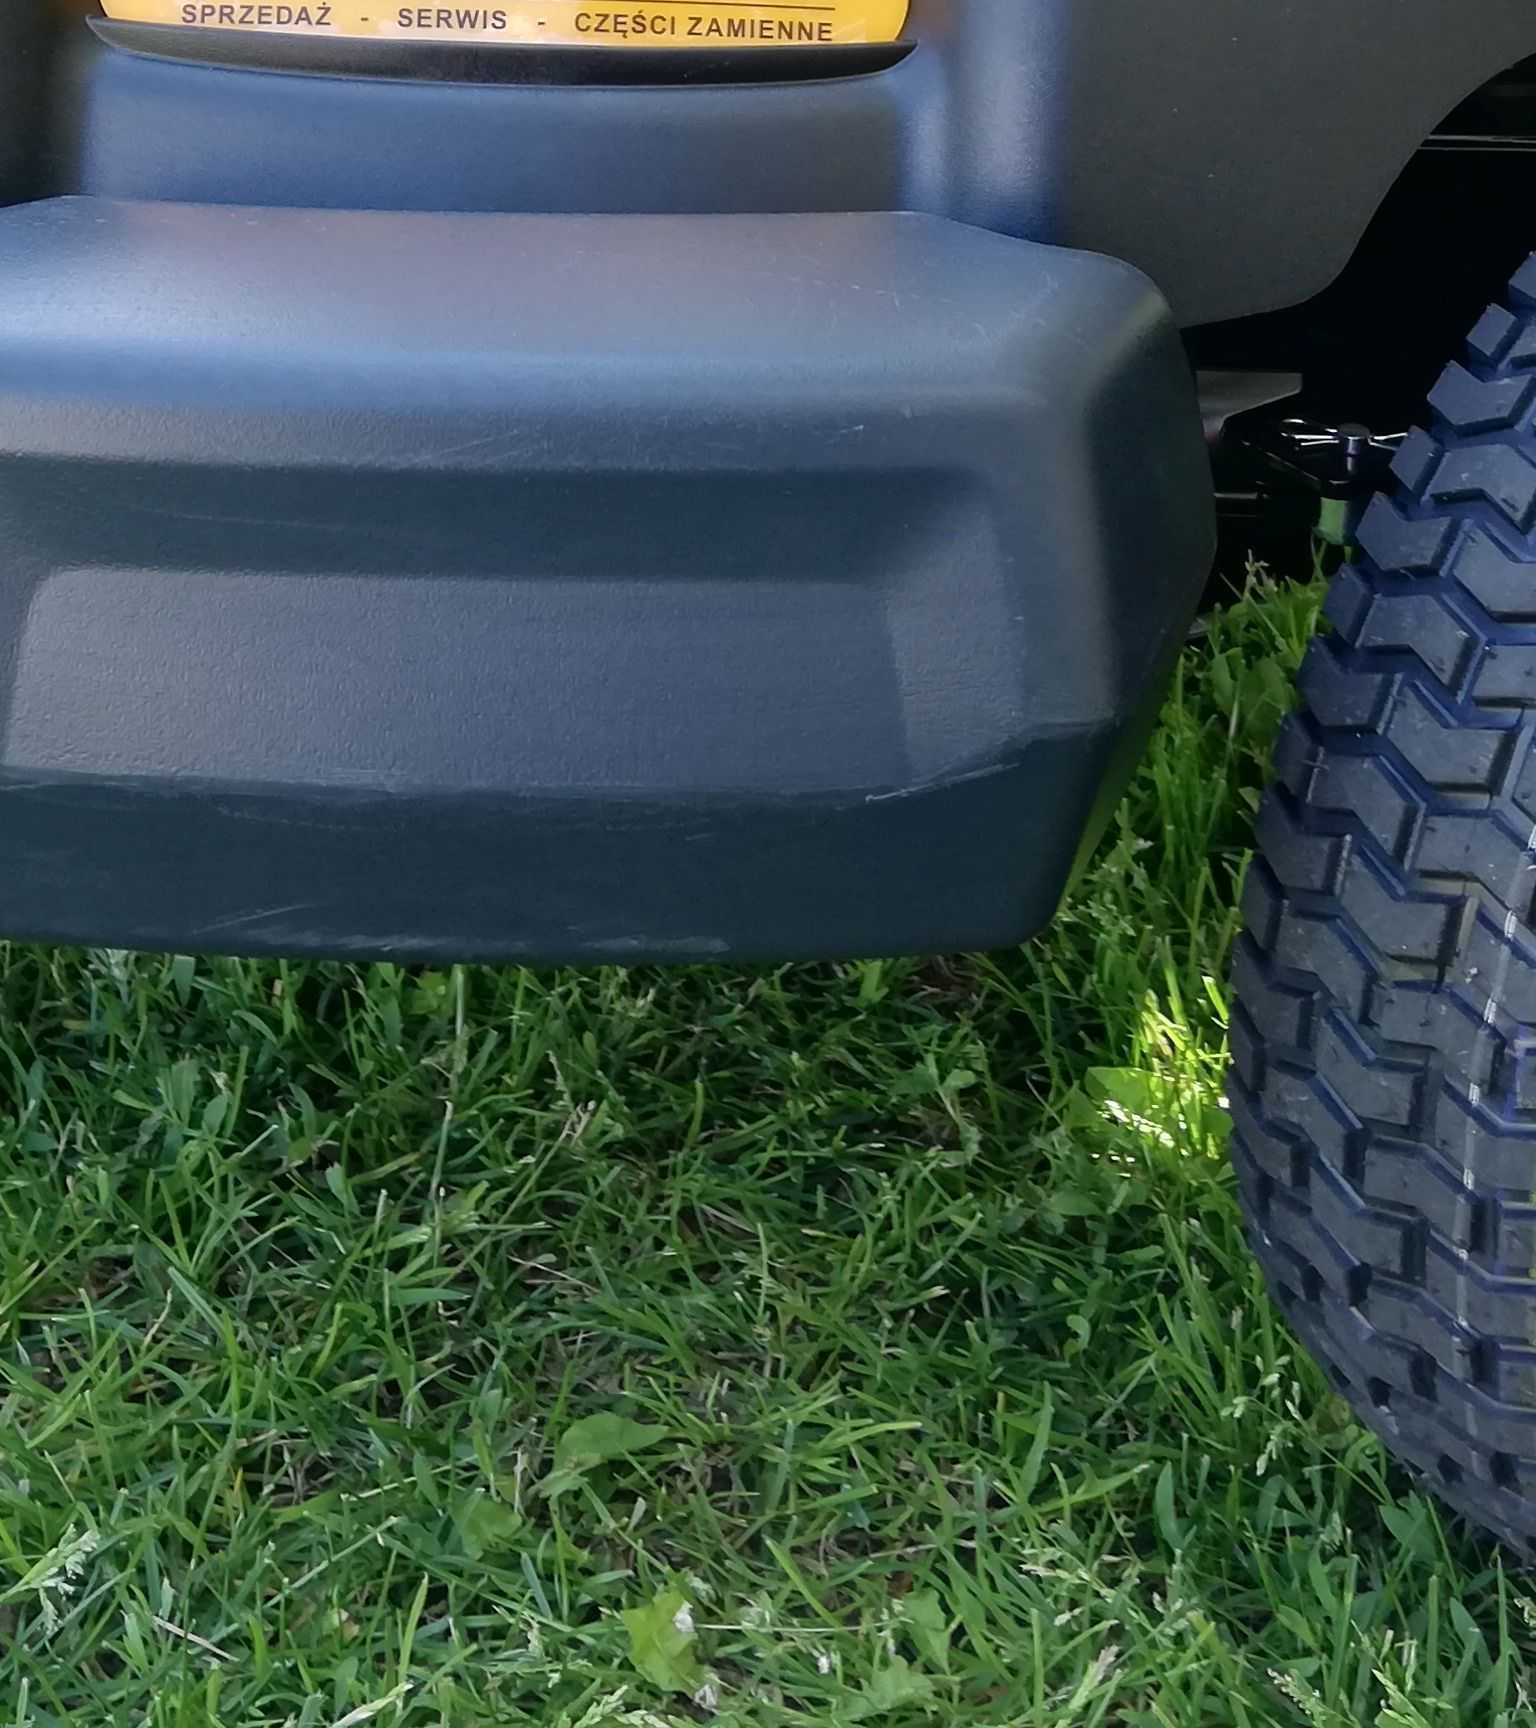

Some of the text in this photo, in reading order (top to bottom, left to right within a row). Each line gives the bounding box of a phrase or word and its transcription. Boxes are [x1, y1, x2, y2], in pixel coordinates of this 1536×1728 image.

[181, 4, 332, 26] SPRZEDAŻ
[397, 7, 507, 30] SERWIS
[574, 9, 676, 39] CZĘŚCI
[686, 16, 833, 42] ZAMIENNE
